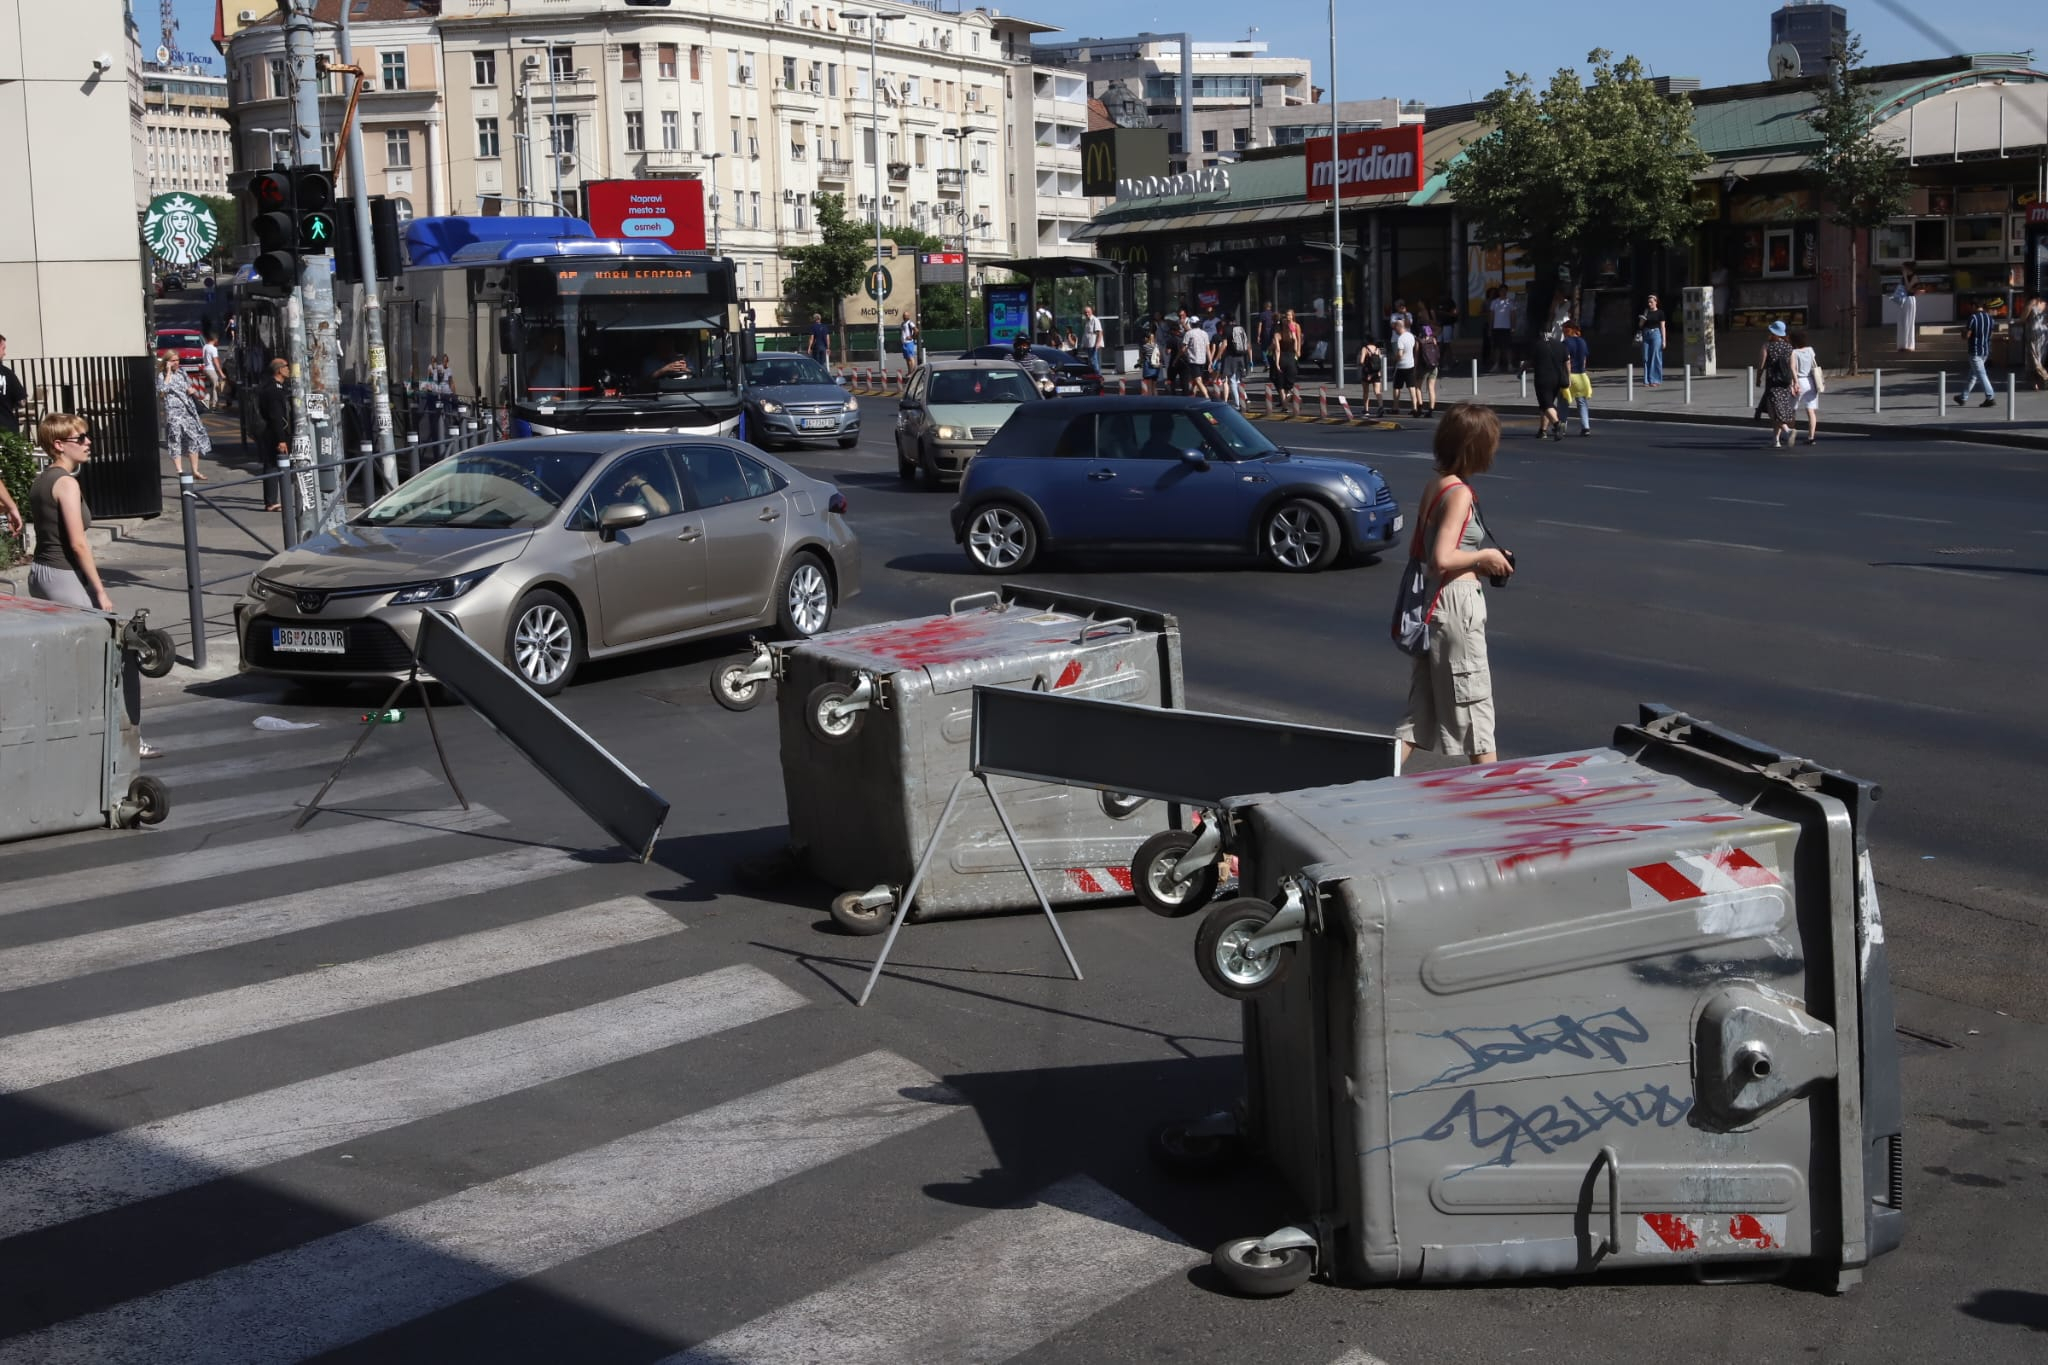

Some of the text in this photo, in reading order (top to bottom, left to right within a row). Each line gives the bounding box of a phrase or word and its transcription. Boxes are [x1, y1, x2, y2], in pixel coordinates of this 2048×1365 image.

[1311, 144, 1414, 187] meridian
[630, 194, 663, 204] Napravi
[628, 206, 654, 214] mesto
[634, 222, 662, 231] osmeh
[280, 630, 293, 645] BG
